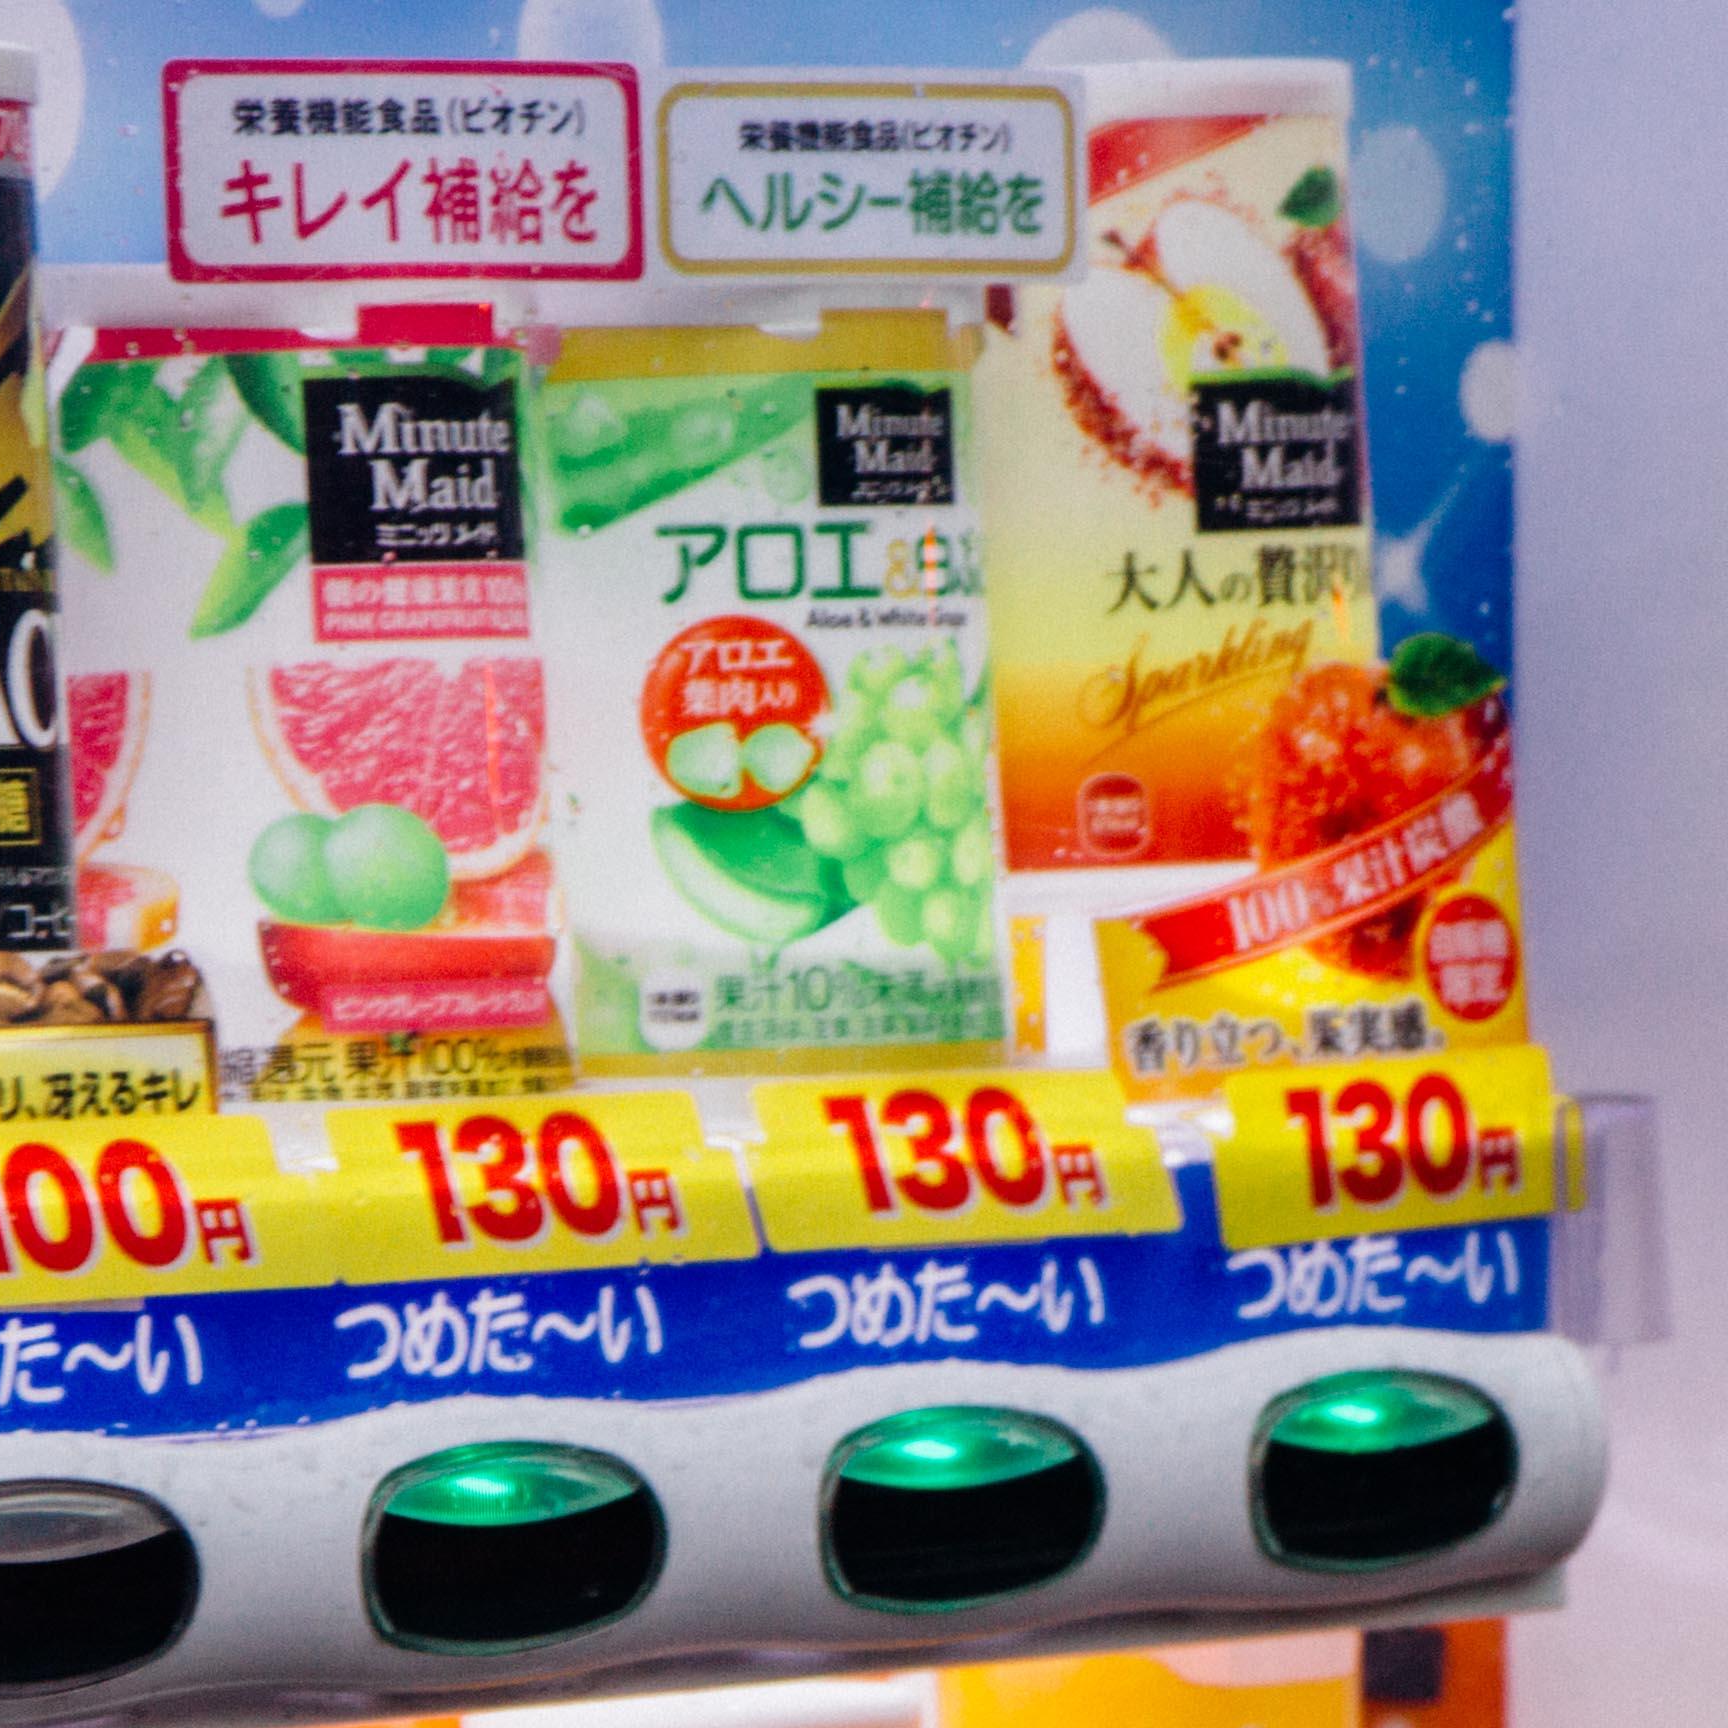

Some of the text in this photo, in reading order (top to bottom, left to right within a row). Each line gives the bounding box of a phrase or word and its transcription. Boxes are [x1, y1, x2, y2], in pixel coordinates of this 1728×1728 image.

[221, 156, 599, 246] キレイ補給を
[702, 169, 1044, 237] ヘルシー補給を
[336, 401, 513, 458] Minute
[836, 402, 944, 438] Minute
[1217, 400, 1354, 446] Minute
[852, 438, 940, 474] Maid
[1238, 445, 1343, 490] Maid
[368, 458, 499, 513] Maid
[676, 638, 795, 674] アロエ
[822, 1086, 1112, 1216] 130円
[1283, 1071, 1523, 1210] 130円
[395, 1111, 688, 1248] 130円
